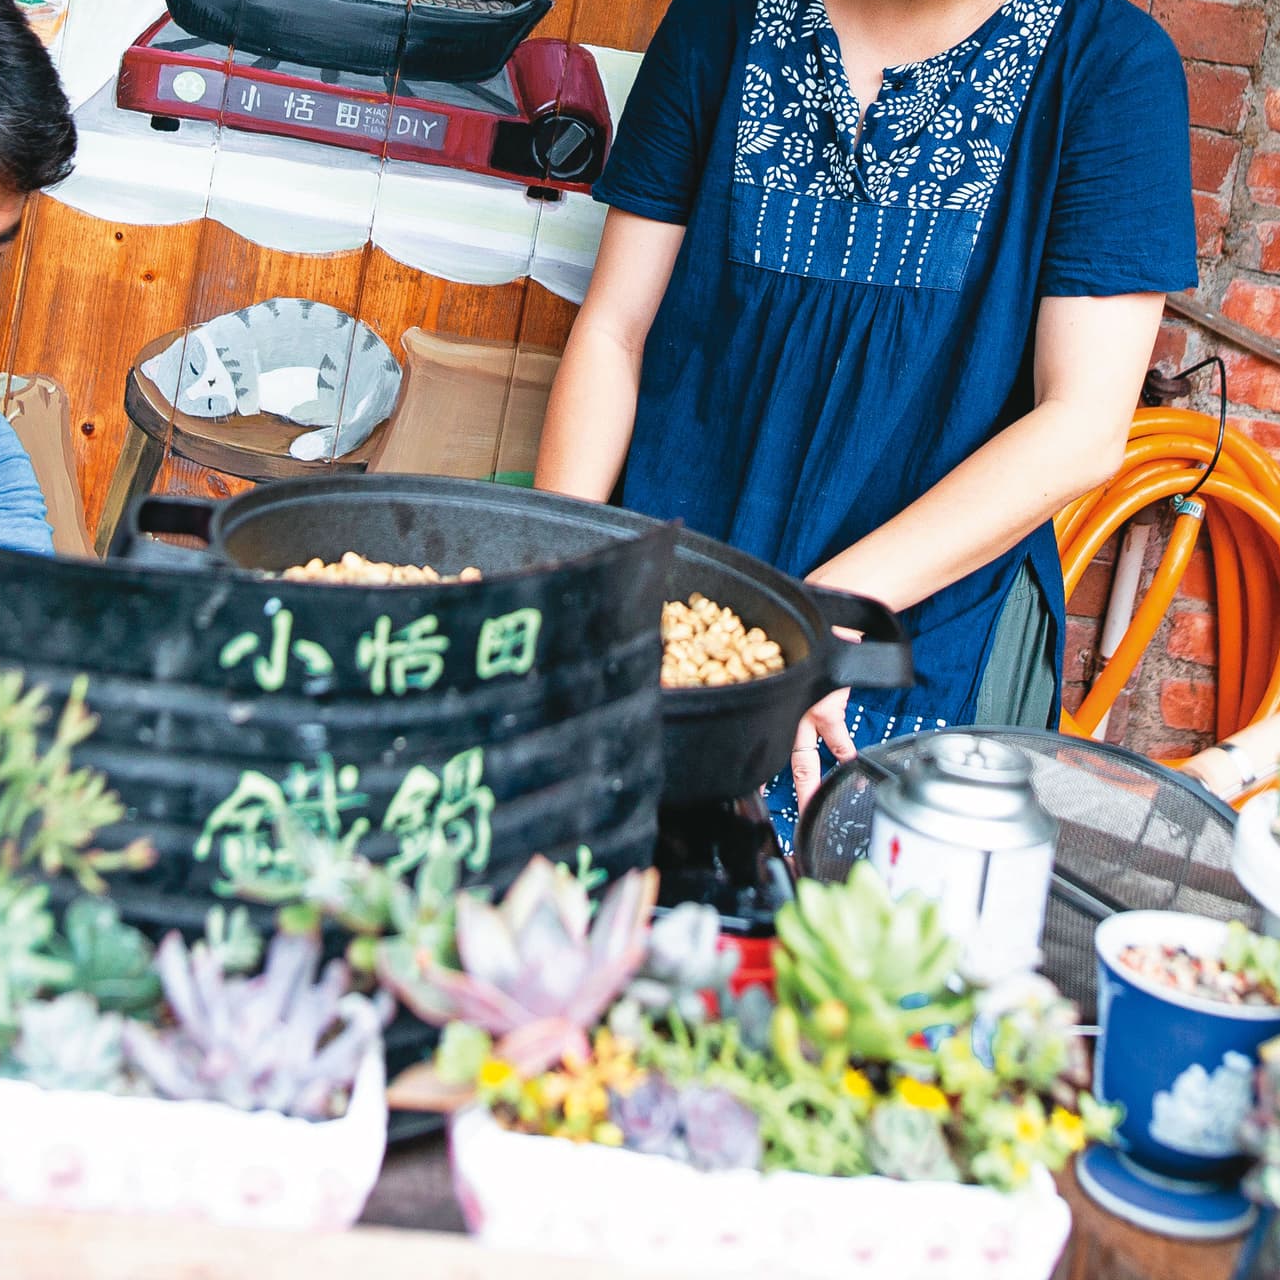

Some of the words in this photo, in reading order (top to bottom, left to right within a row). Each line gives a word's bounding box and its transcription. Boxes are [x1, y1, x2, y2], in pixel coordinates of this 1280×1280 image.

[240, 84, 361, 128] 小恬田
[396, 114, 438, 140] DIY
[220, 608, 543, 696] 小恬田
